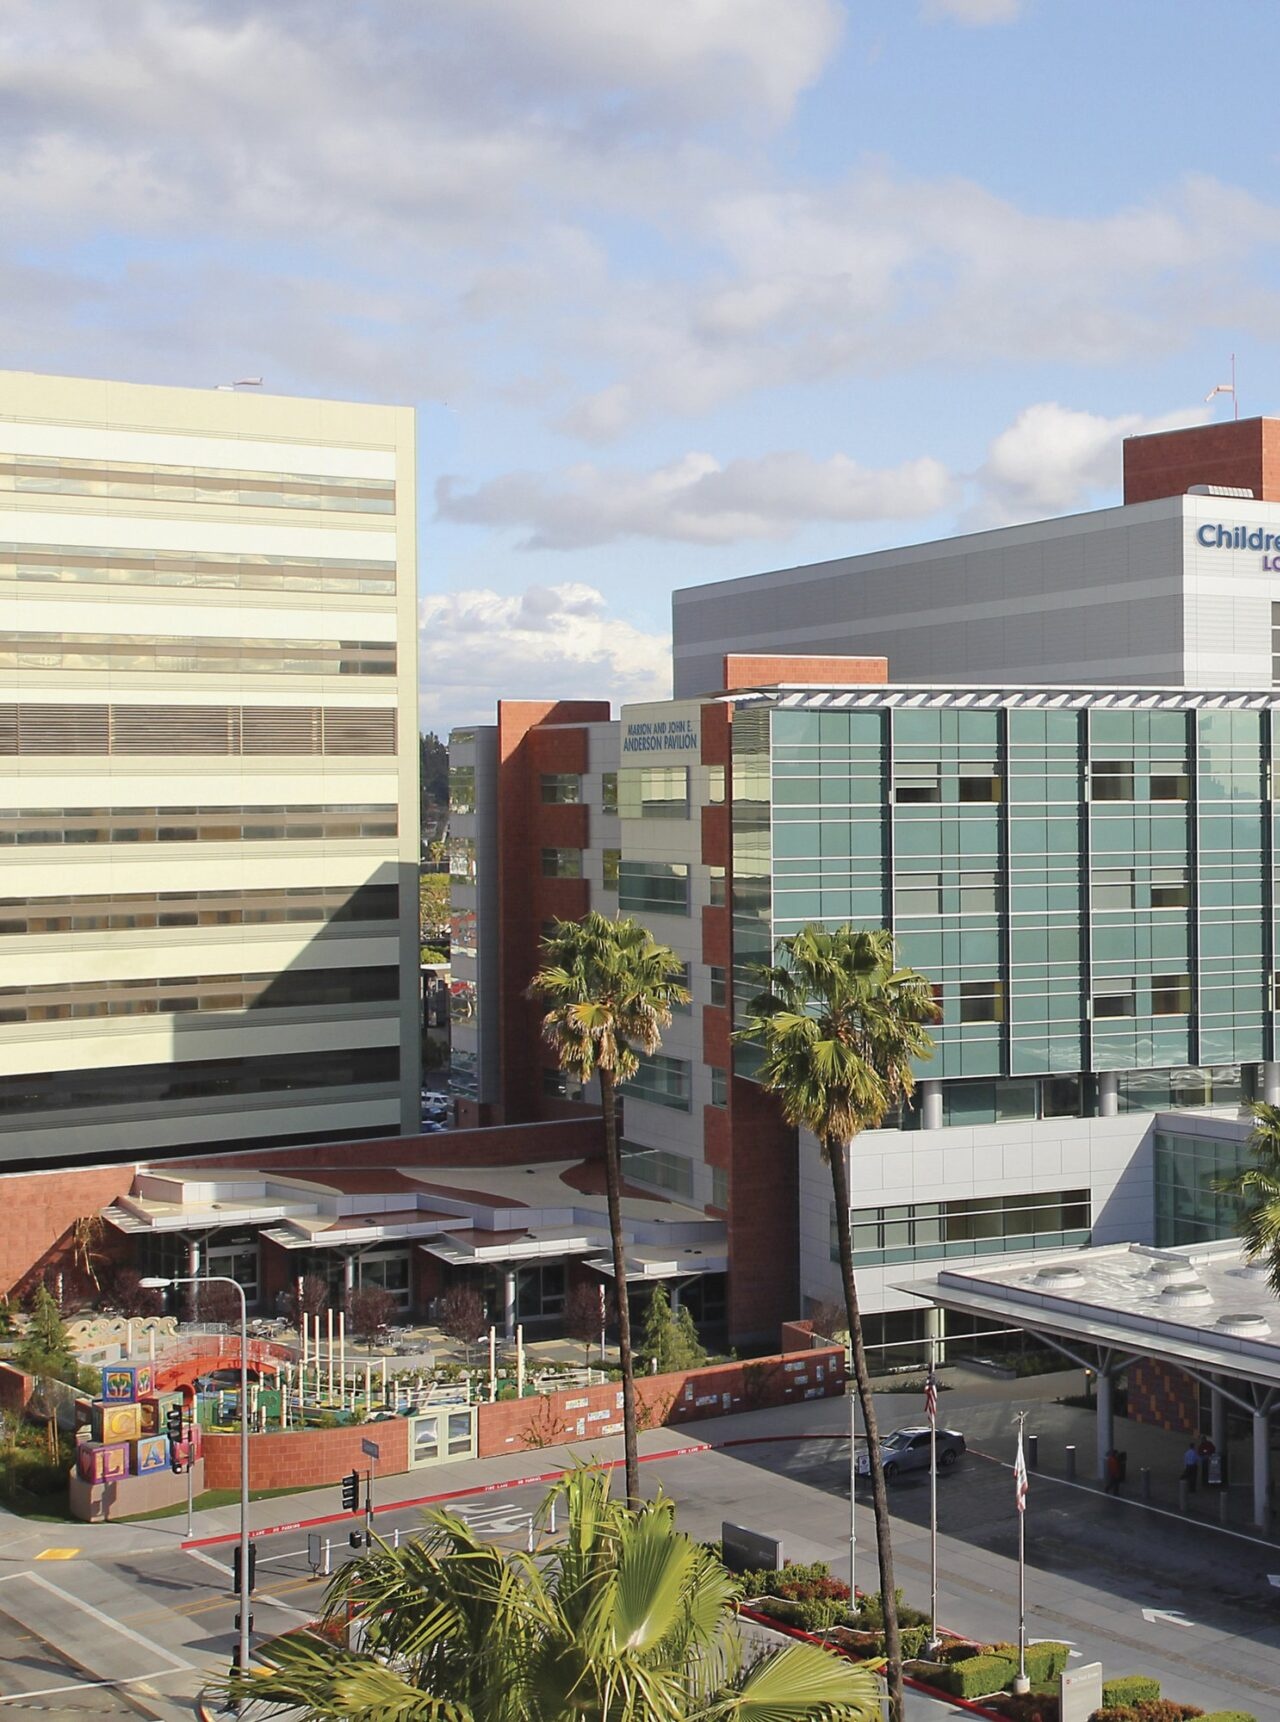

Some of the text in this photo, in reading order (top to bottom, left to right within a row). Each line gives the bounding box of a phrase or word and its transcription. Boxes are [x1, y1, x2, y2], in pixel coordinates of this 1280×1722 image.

[628, 724, 651, 736] MARION
[653, 722, 666, 734] AND
[668, 720, 686, 734] JOHN
[623, 733, 697, 752] ANDERSON PAVILION
[112, 1411, 131, 1434] C
[103, 1444, 163, 1475] L A
